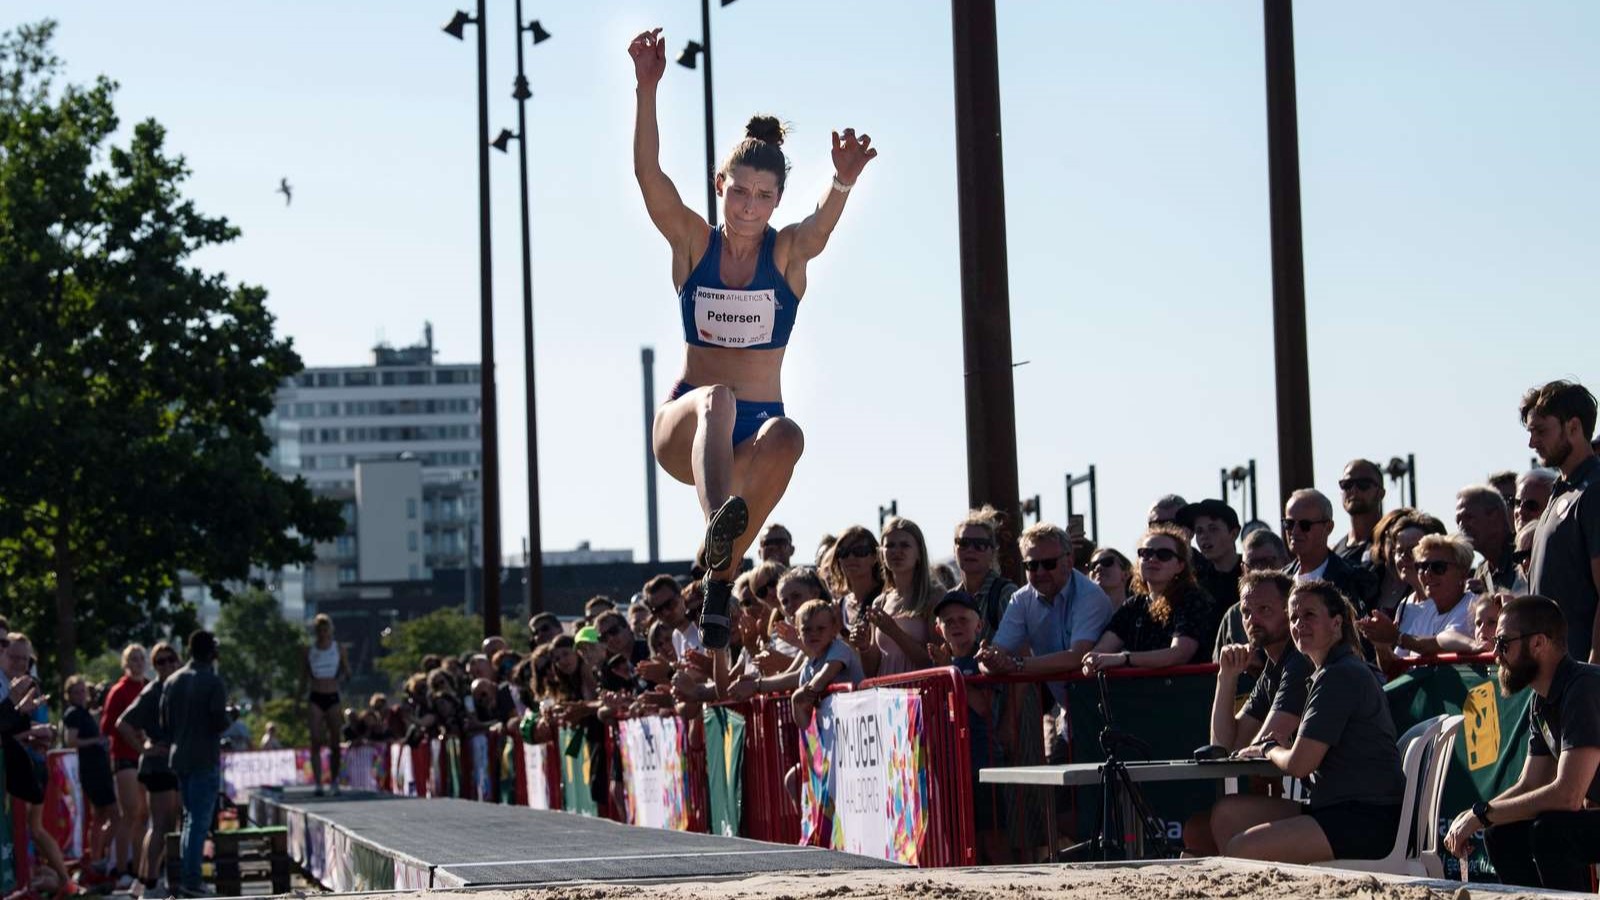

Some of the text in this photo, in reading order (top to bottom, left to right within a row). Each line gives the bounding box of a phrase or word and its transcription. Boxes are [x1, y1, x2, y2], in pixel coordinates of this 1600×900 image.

[698, 291, 763, 302] ROSTER ATHLETICS
[707, 310, 761, 323] Petersen
